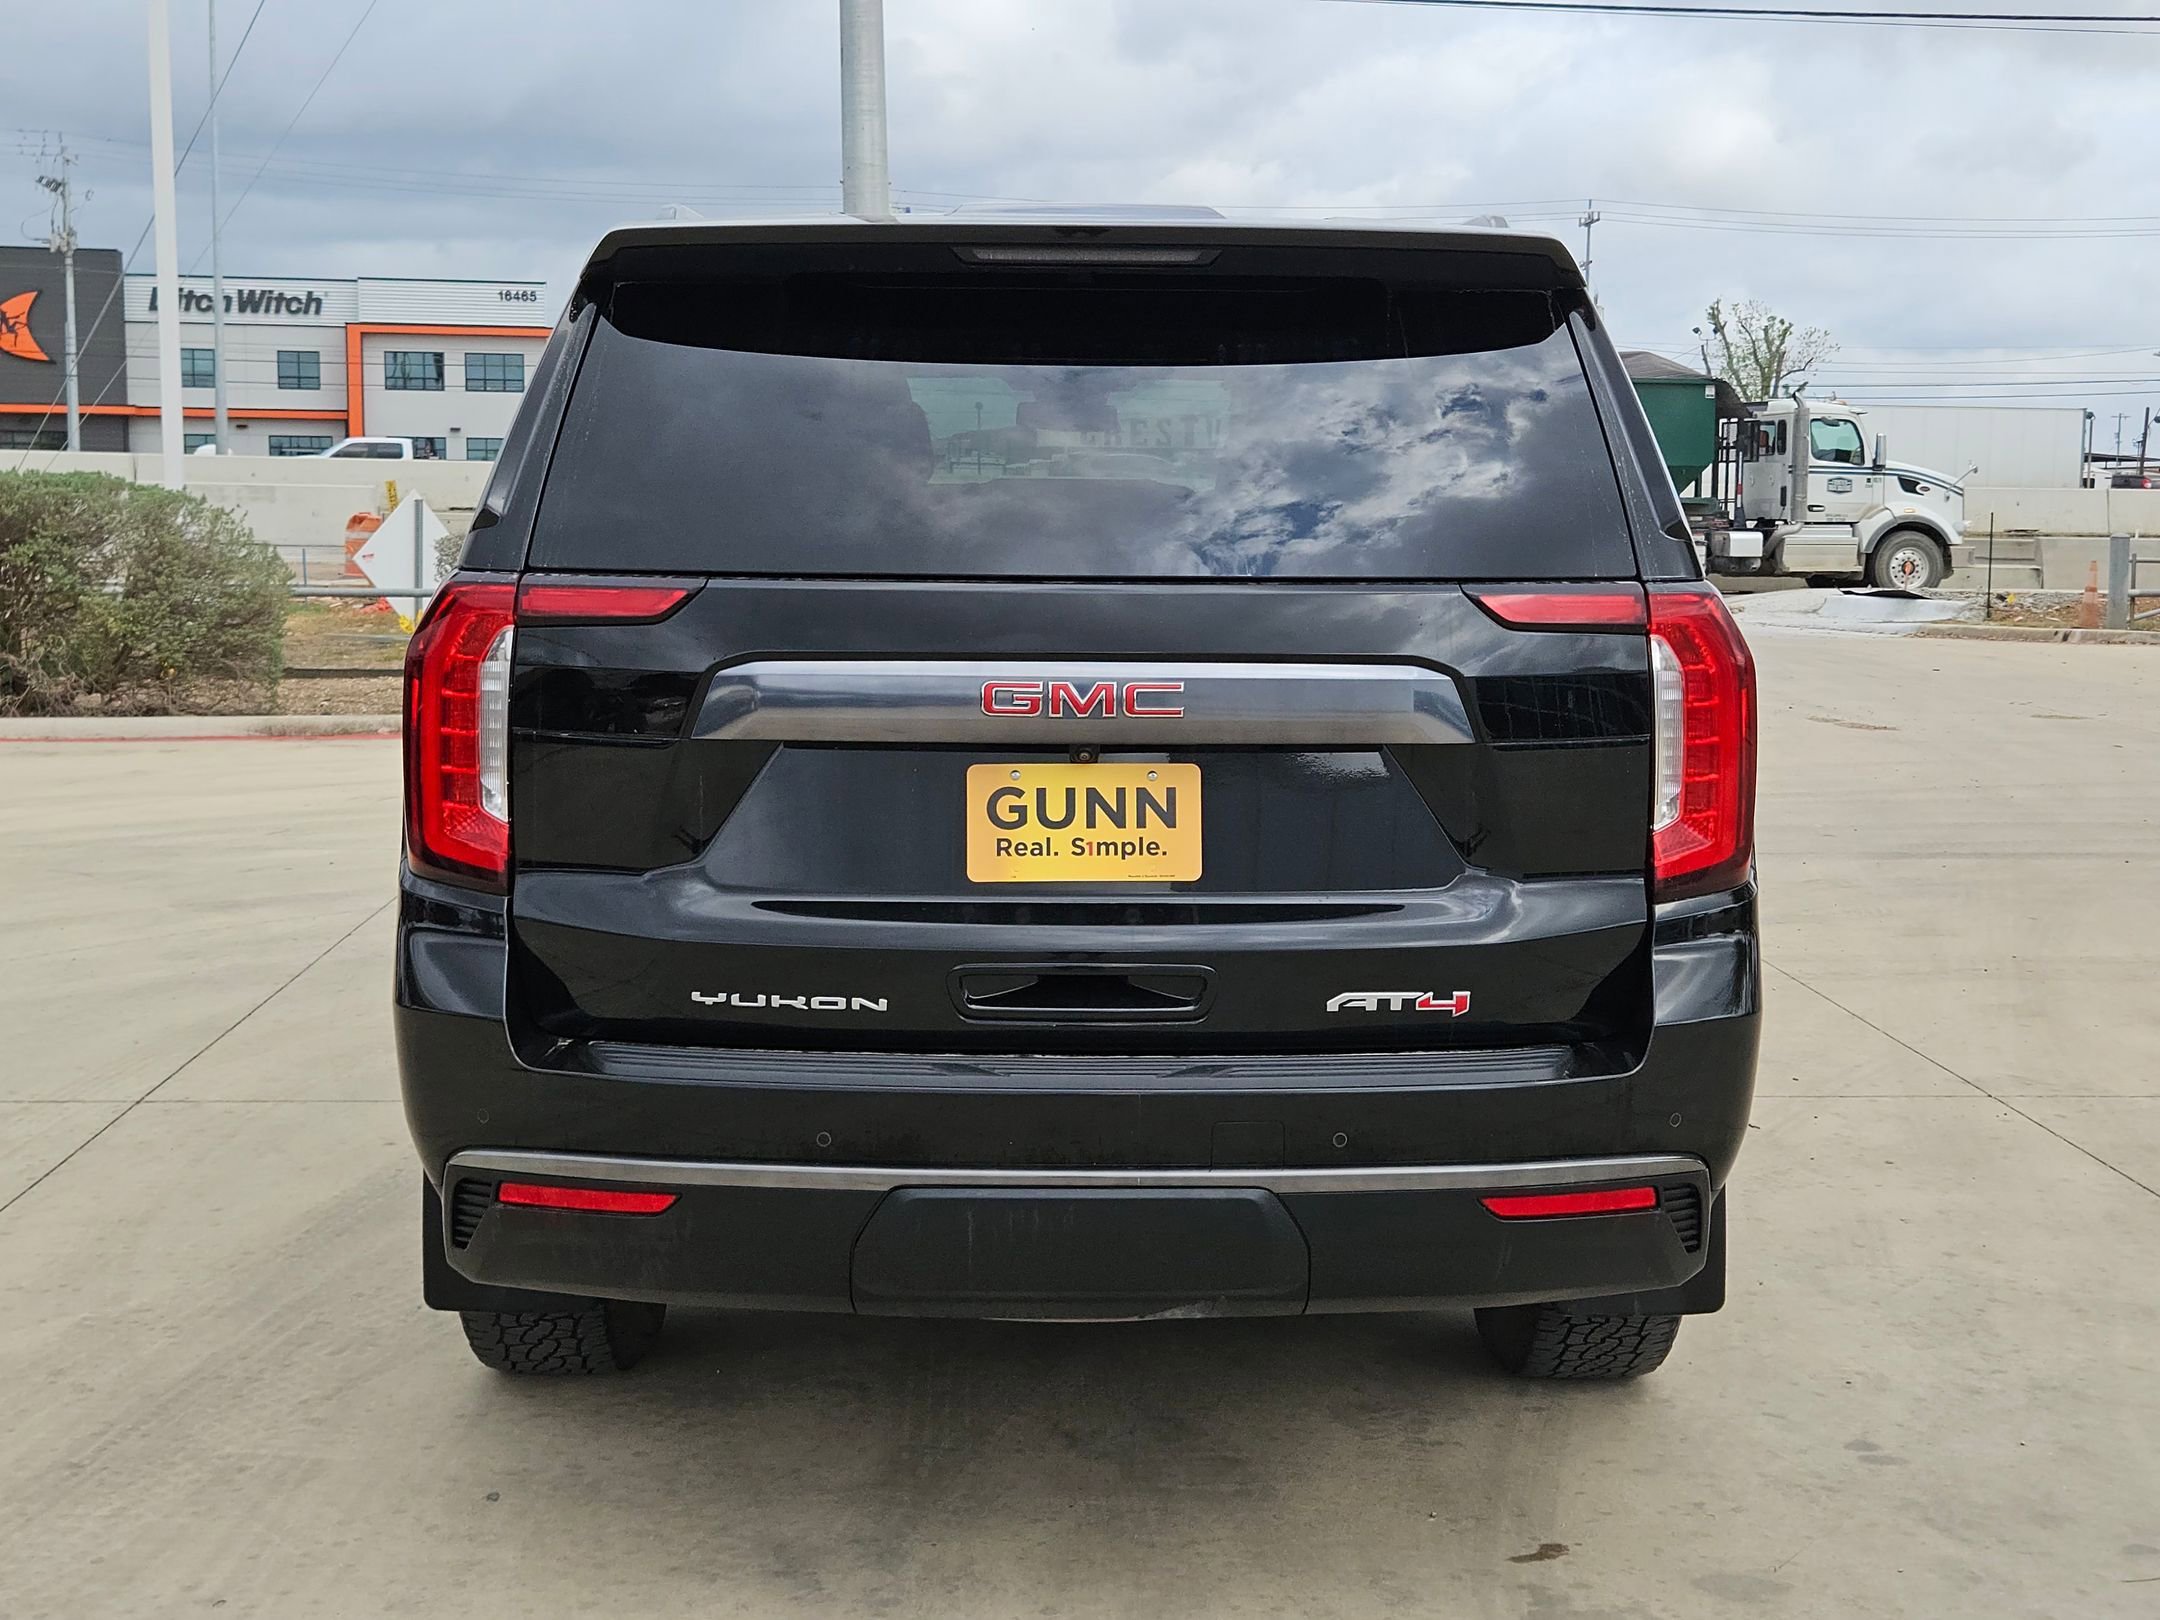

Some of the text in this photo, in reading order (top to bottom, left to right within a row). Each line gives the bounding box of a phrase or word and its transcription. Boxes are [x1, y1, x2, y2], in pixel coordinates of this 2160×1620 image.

[237, 289, 323, 315] Witch
[497, 290, 537, 302] 16465
[980, 680, 1185, 718] GMC
[986, 786, 1177, 830] GUNN
[996, 837, 1059, 857] Real.
[691, 991, 888, 1012] YUKON
[1326, 991, 1471, 1017] AT4
